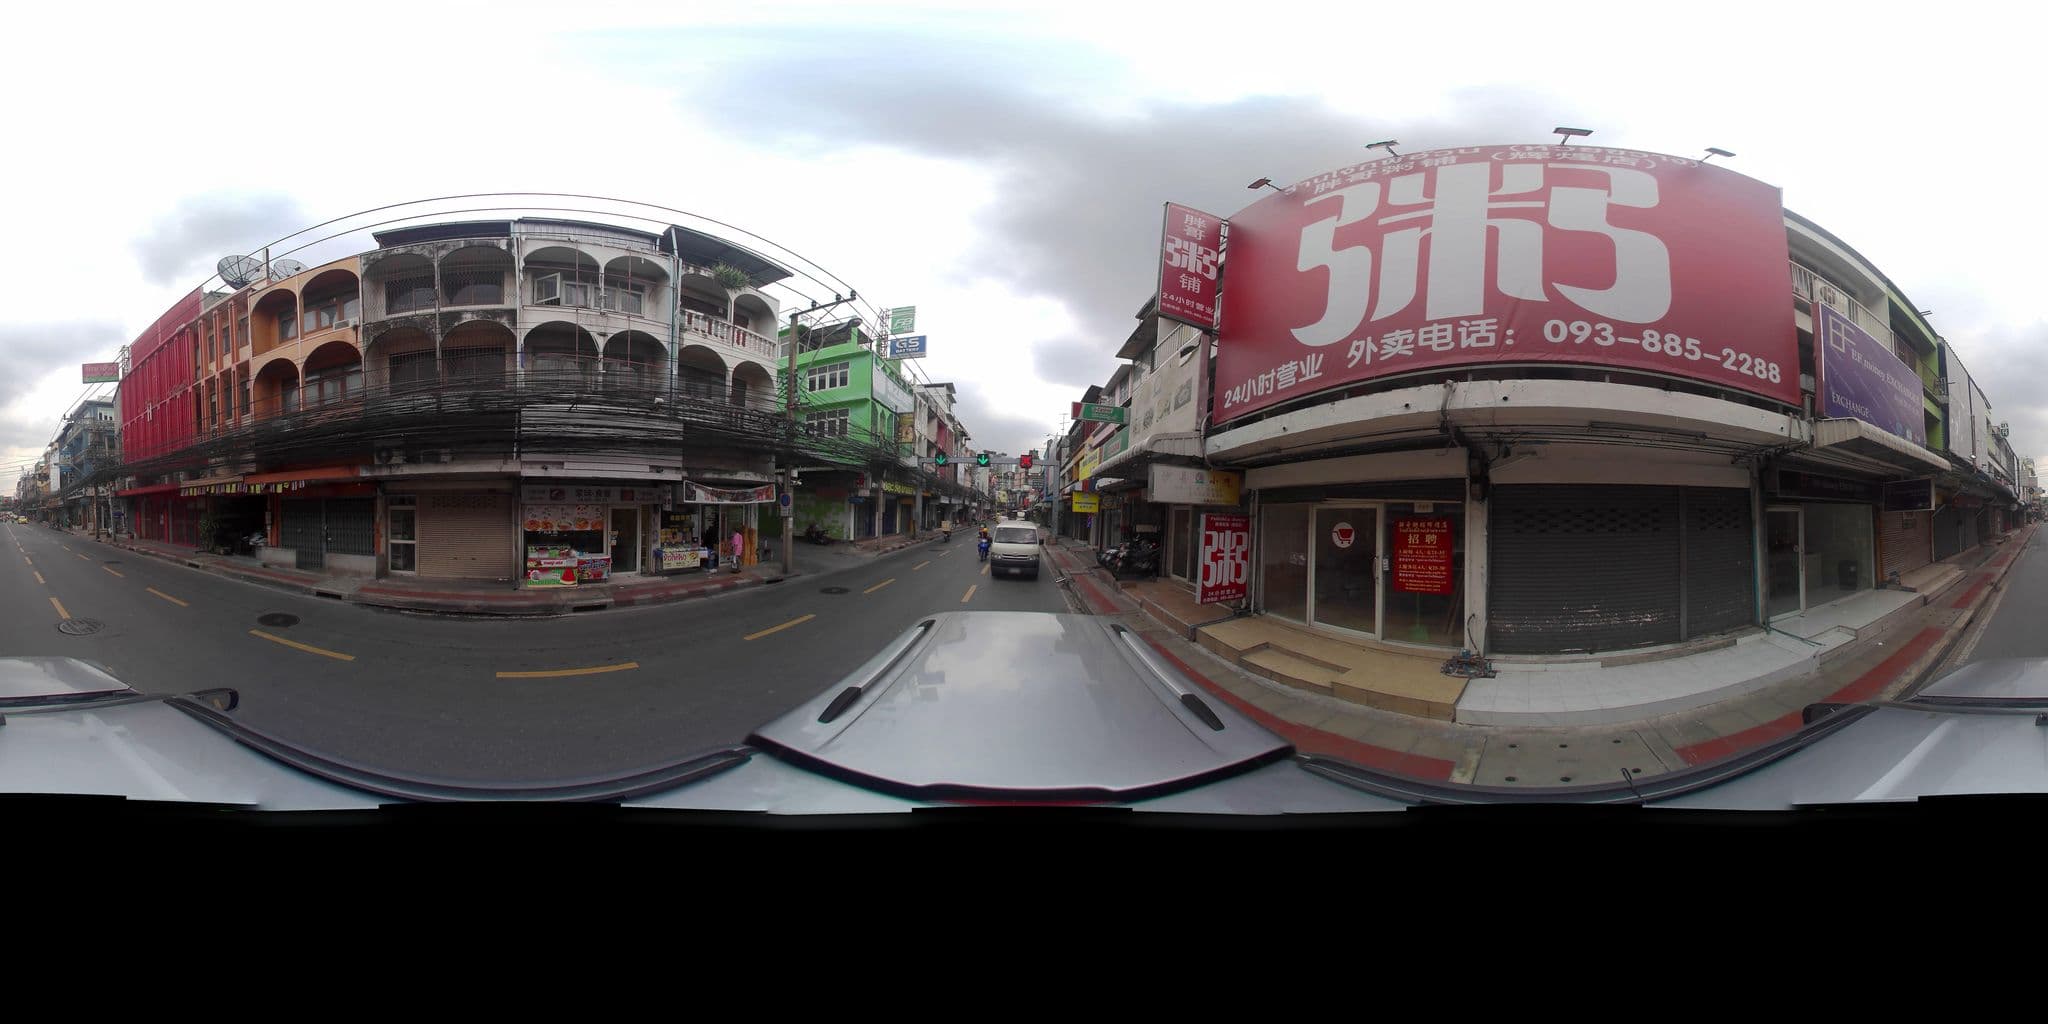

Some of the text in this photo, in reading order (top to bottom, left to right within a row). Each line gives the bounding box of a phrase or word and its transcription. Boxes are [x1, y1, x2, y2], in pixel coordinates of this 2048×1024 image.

[1165, 234, 1218, 280] 粥
[1290, 161, 1672, 347] 粥
[1179, 273, 1202, 294] 铺
[1162, 292, 1214, 315] 24小时营业
[895, 337, 920, 348] GS
[1347, 317, 1782, 385] 外卖电话： 093-885-2288
[1223, 352, 1325, 410] 24小时营业
[1832, 392, 1869, 417] EXCHANGE
[1407, 533, 1437, 545] 招聘
[1203, 530, 1248, 588] 粥
